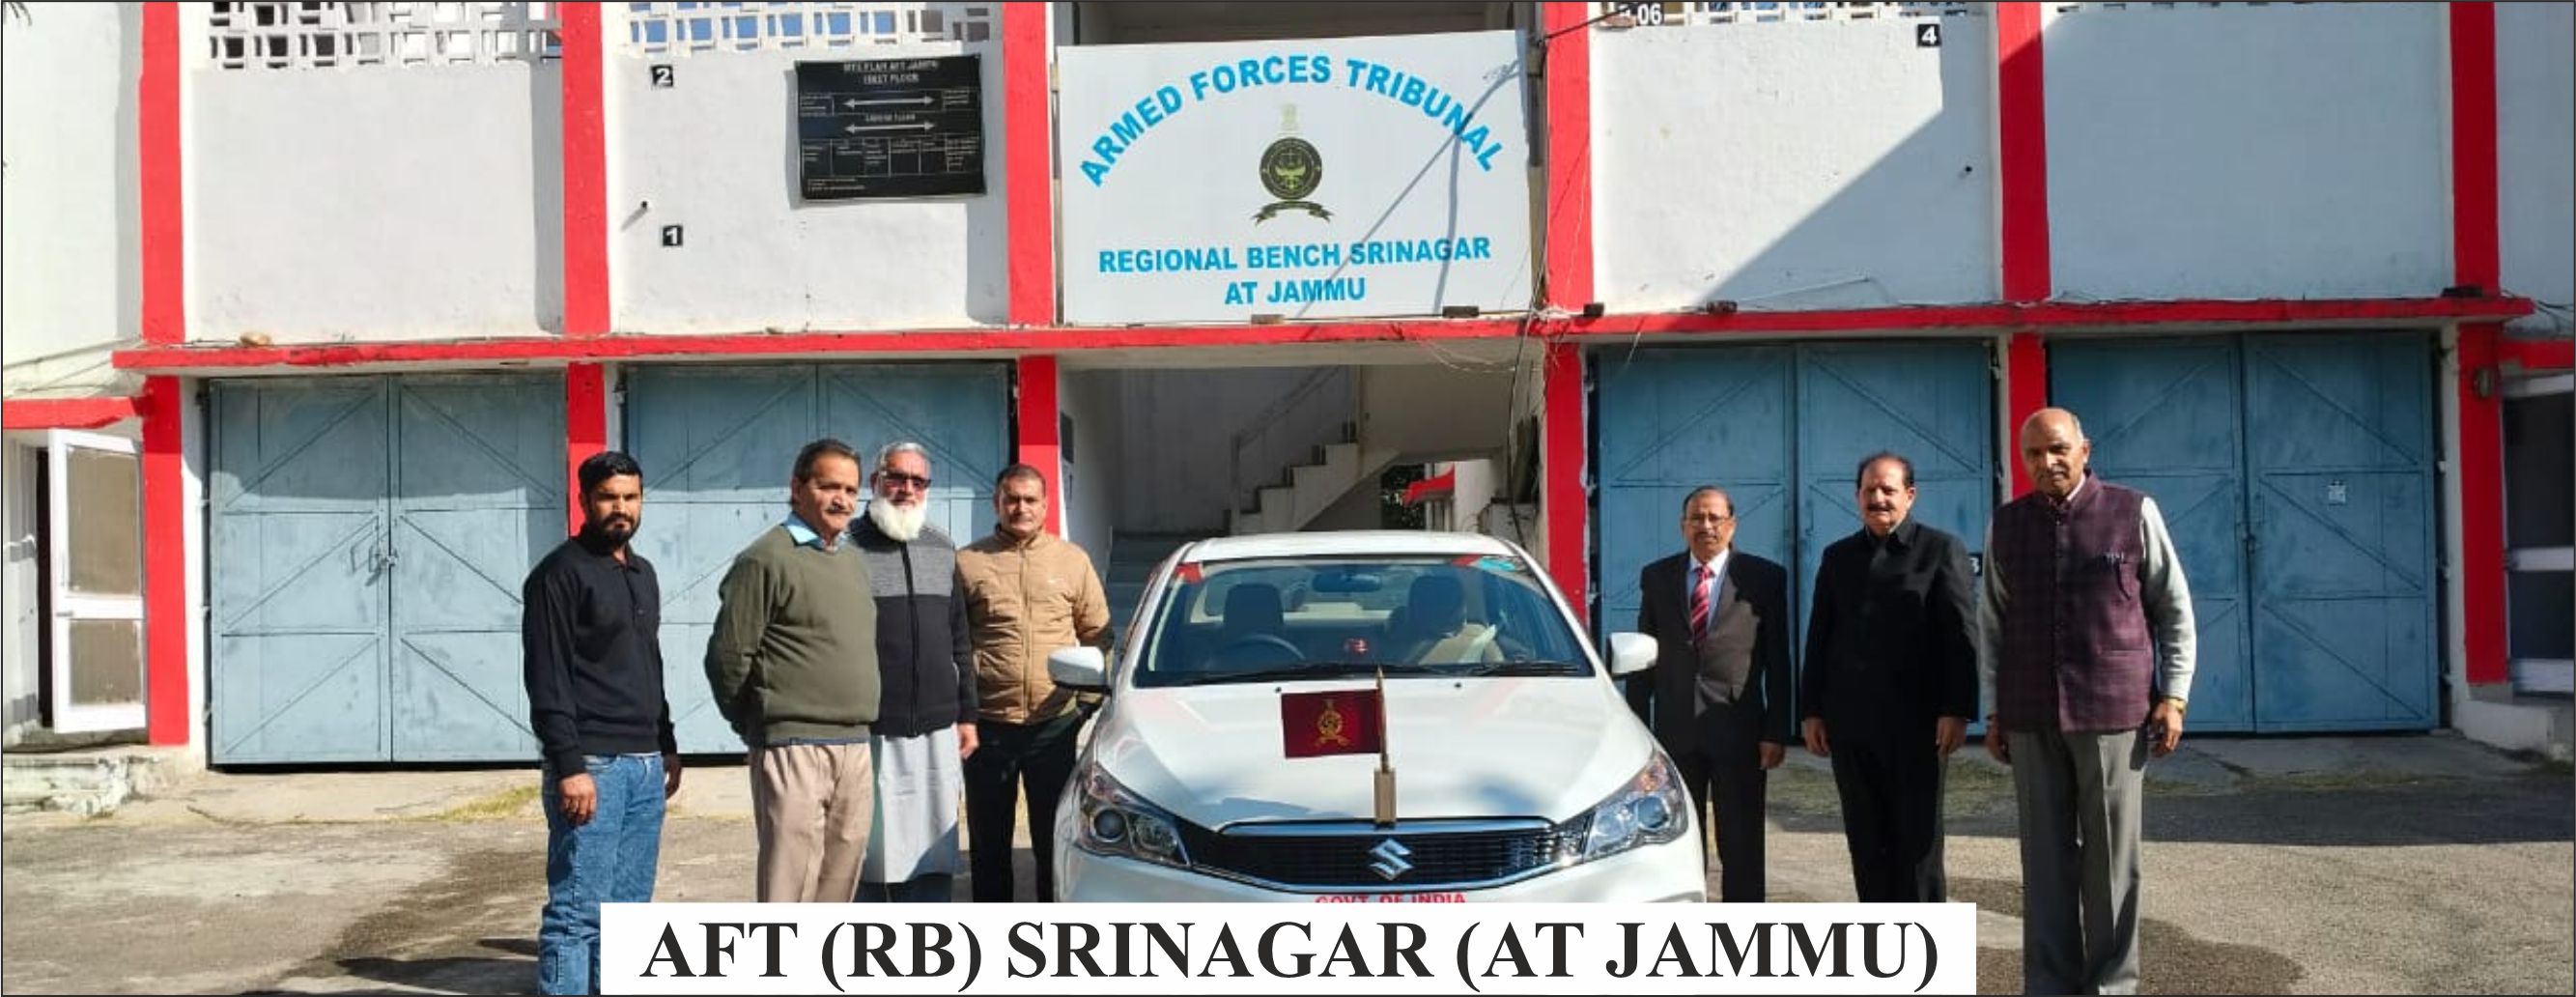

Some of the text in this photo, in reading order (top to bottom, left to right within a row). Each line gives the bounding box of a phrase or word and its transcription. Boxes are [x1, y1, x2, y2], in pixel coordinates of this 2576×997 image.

[1921, 25, 1938, 44] 4
[655, 67, 672, 85] 2
[1080, 84, 1184, 187] ARMED
[1189, 53, 1333, 101] FORCES
[1345, 58, 1504, 173] TRIBUNAL
[665, 226, 678, 245] 1
[1098, 236, 1490, 274] REGIONAL BENCH SRINAGAR
[1224, 276, 1367, 305] AT JAMMU
